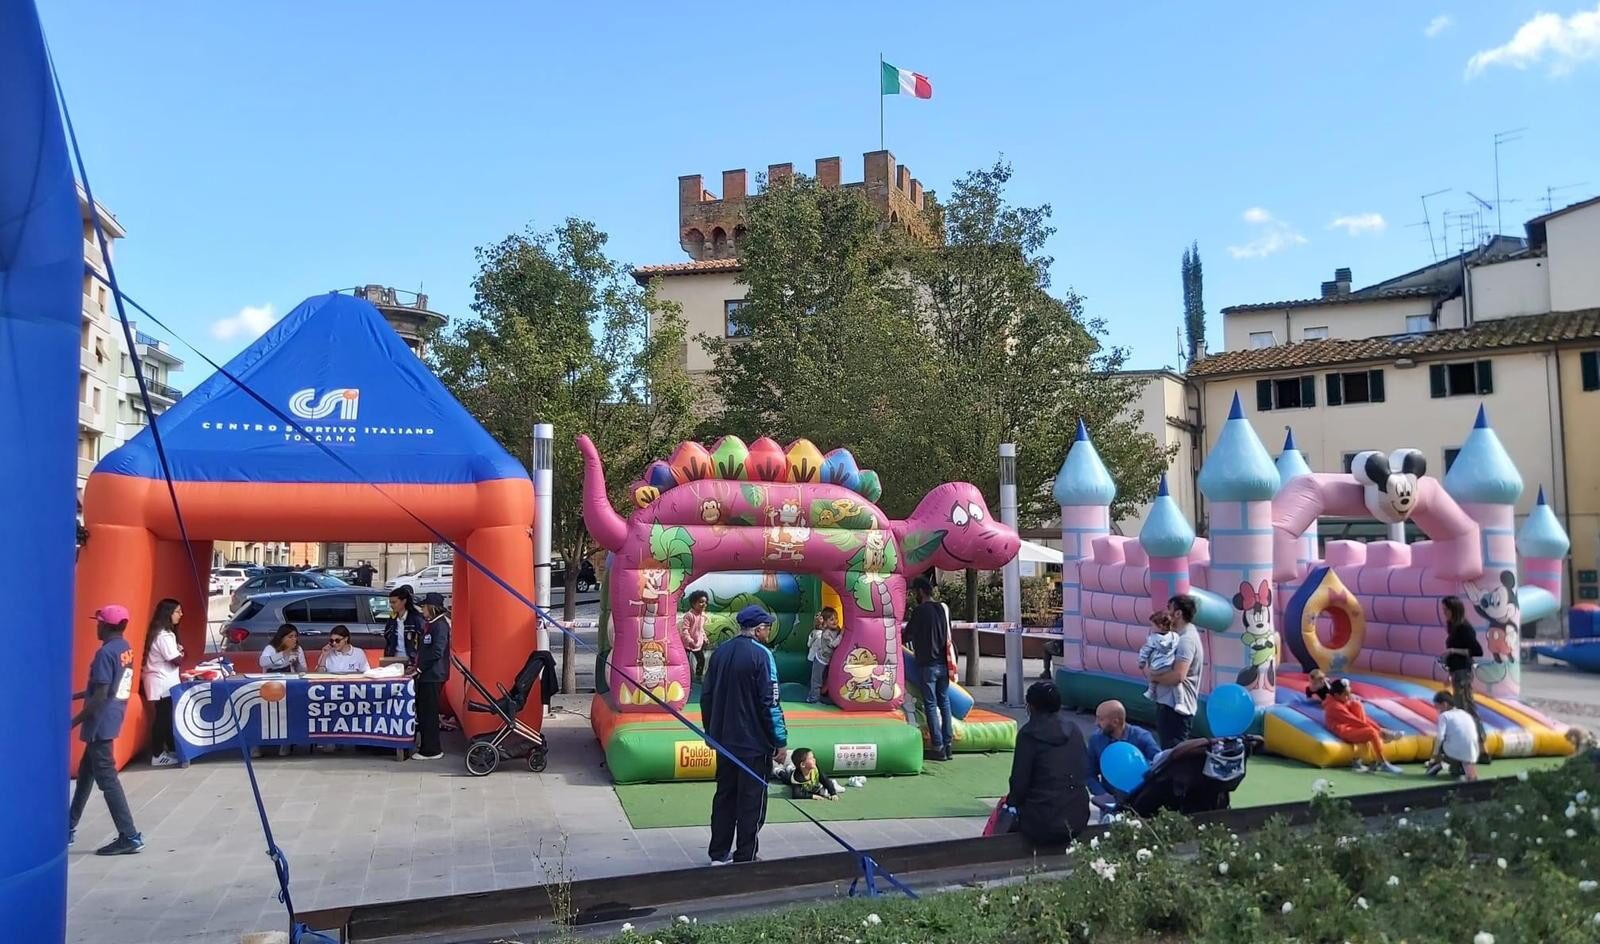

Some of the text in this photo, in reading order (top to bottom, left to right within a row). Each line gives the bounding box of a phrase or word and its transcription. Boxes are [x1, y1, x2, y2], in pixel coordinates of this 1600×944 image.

[202, 422, 434, 435] CENTRO SORTIVO ITALIANO
